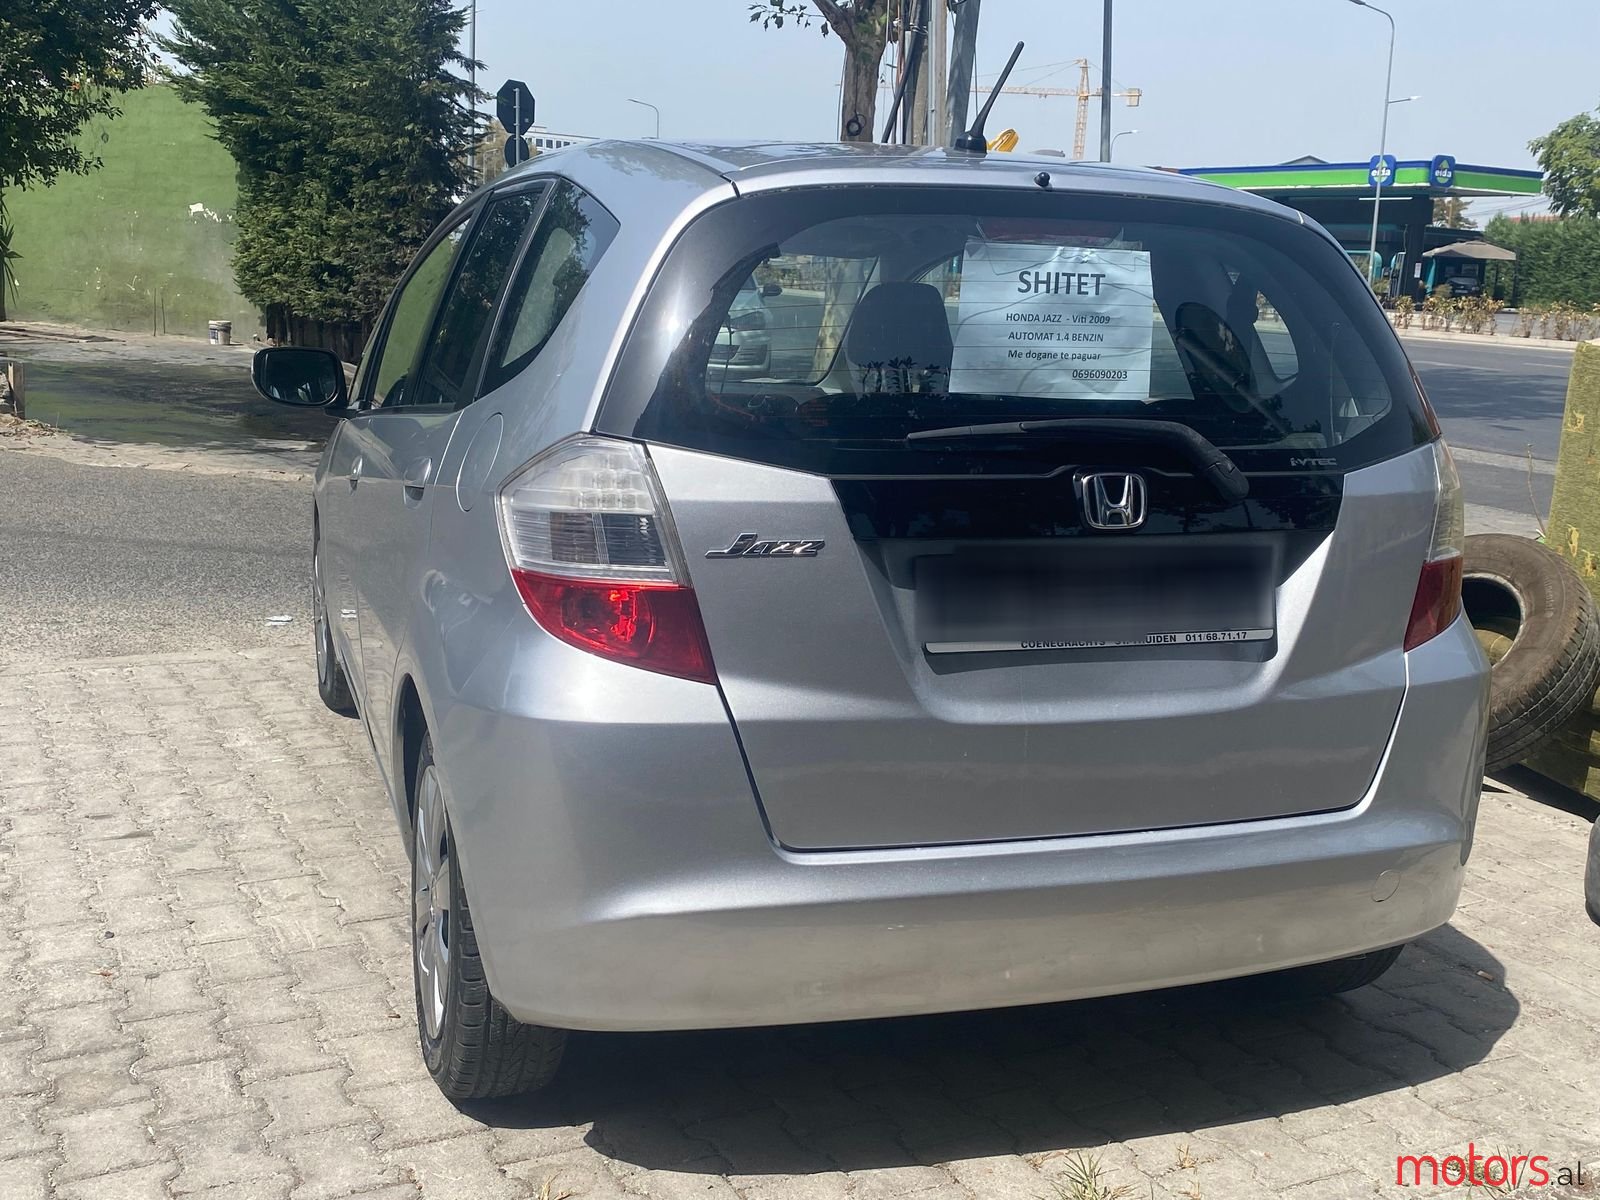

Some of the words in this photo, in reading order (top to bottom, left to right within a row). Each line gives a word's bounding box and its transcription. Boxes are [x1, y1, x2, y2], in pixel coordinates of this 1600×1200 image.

[1018, 271, 1106, 296] SHITET
[1006, 313, 1040, 323] HONDA
[1042, 314, 1062, 323] JAZZ
[1072, 315, 1087, 324] Viti
[1089, 315, 1111, 324] 2009
[1008, 332, 1054, 341] AUTOMAT
[1056, 332, 1070, 341] 1.4
[1072, 333, 1104, 342] BENZIN
[1008, 350, 1023, 359] Me
[1025, 350, 1058, 361] dogane
[1060, 351, 1070, 360] te
[1071, 352, 1101, 362] paguar
[1072, 369, 1128, 380] 0696090203
[1185, 631, 1247, 642] 011/68.71.17
